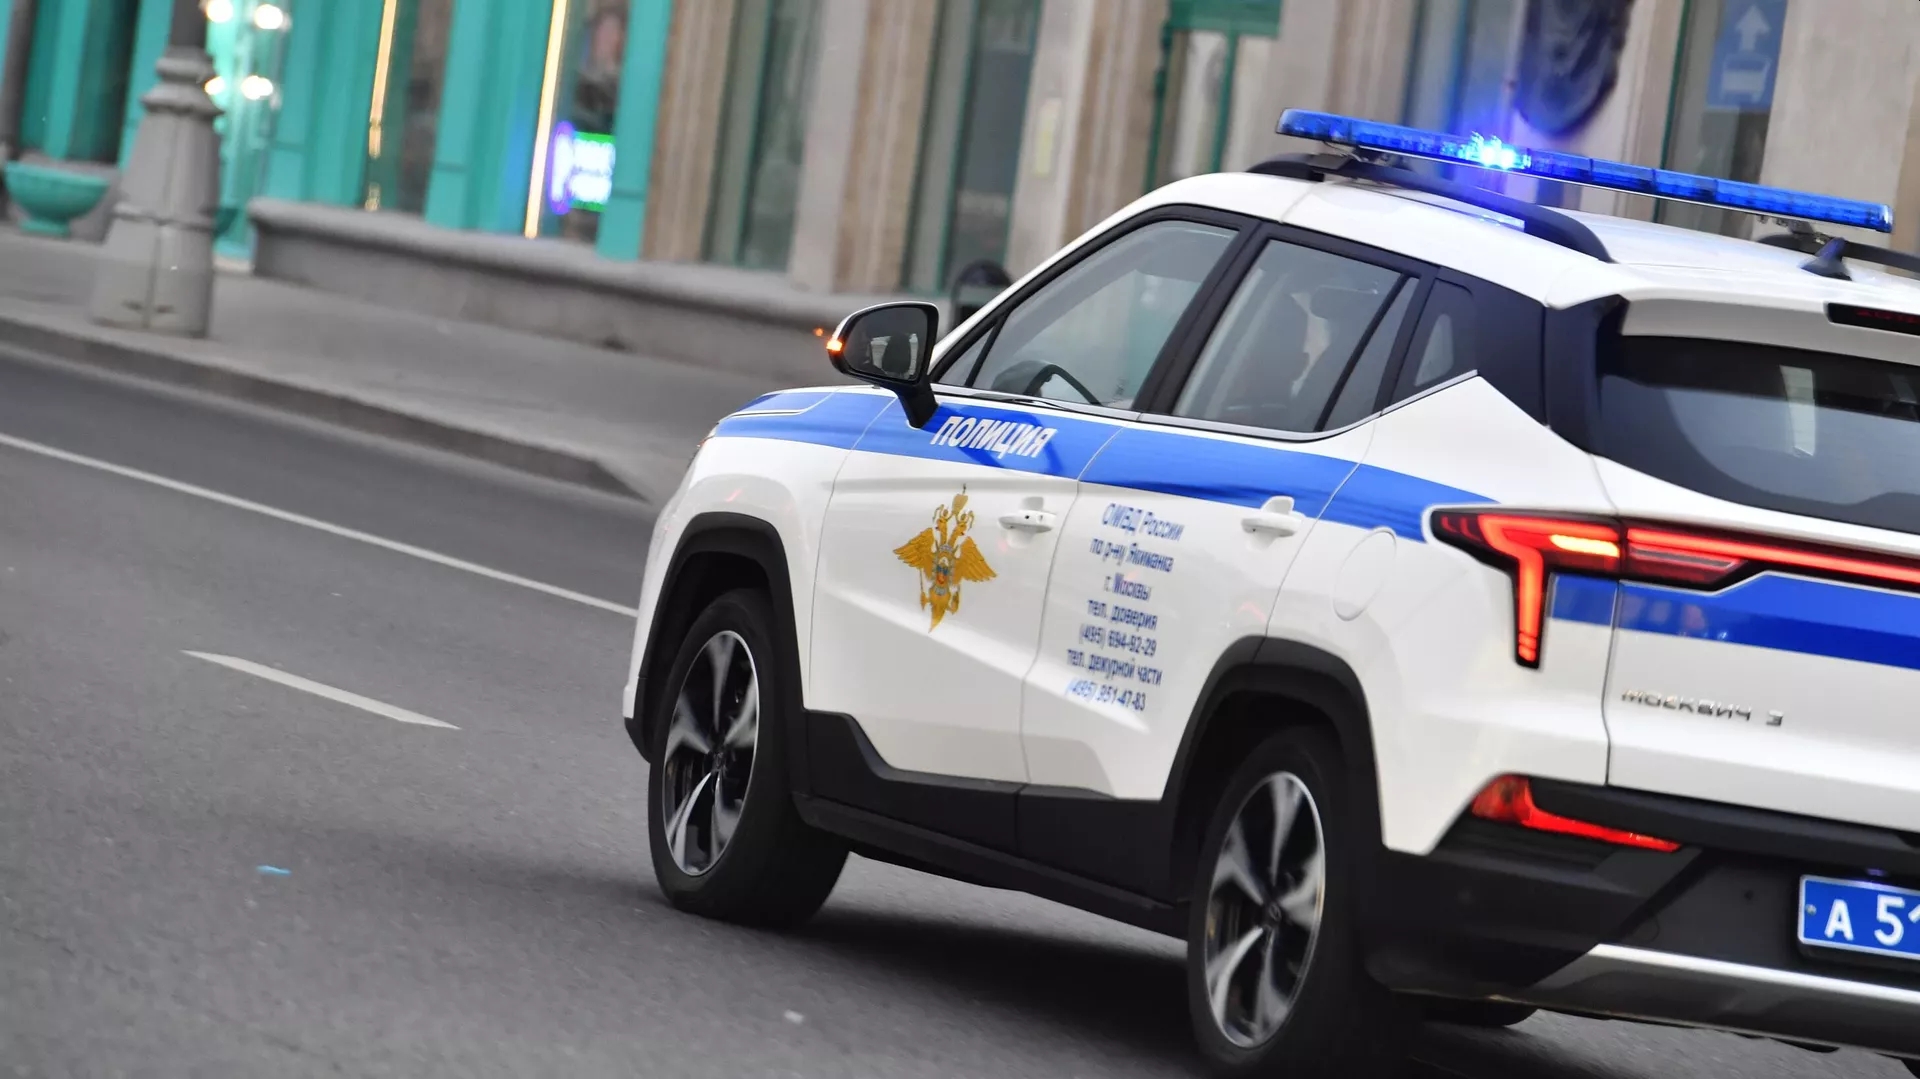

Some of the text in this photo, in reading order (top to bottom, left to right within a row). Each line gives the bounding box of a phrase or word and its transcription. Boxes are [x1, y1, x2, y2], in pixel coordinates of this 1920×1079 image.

[930, 416, 1058, 459] ПОЛИЦИЯ
[1139, 511, 1185, 541] России
[1090, 538, 1174, 572] по р-ну Якиманка
[1112, 572, 1152, 601] Москвы
[1088, 599, 1158, 632] тел. доверия
[1079, 623, 1106, 650] (495)
[1067, 649, 1162, 685] тел. дежурной части
[1622, 689, 1784, 726] МОСКВИЧ 3
